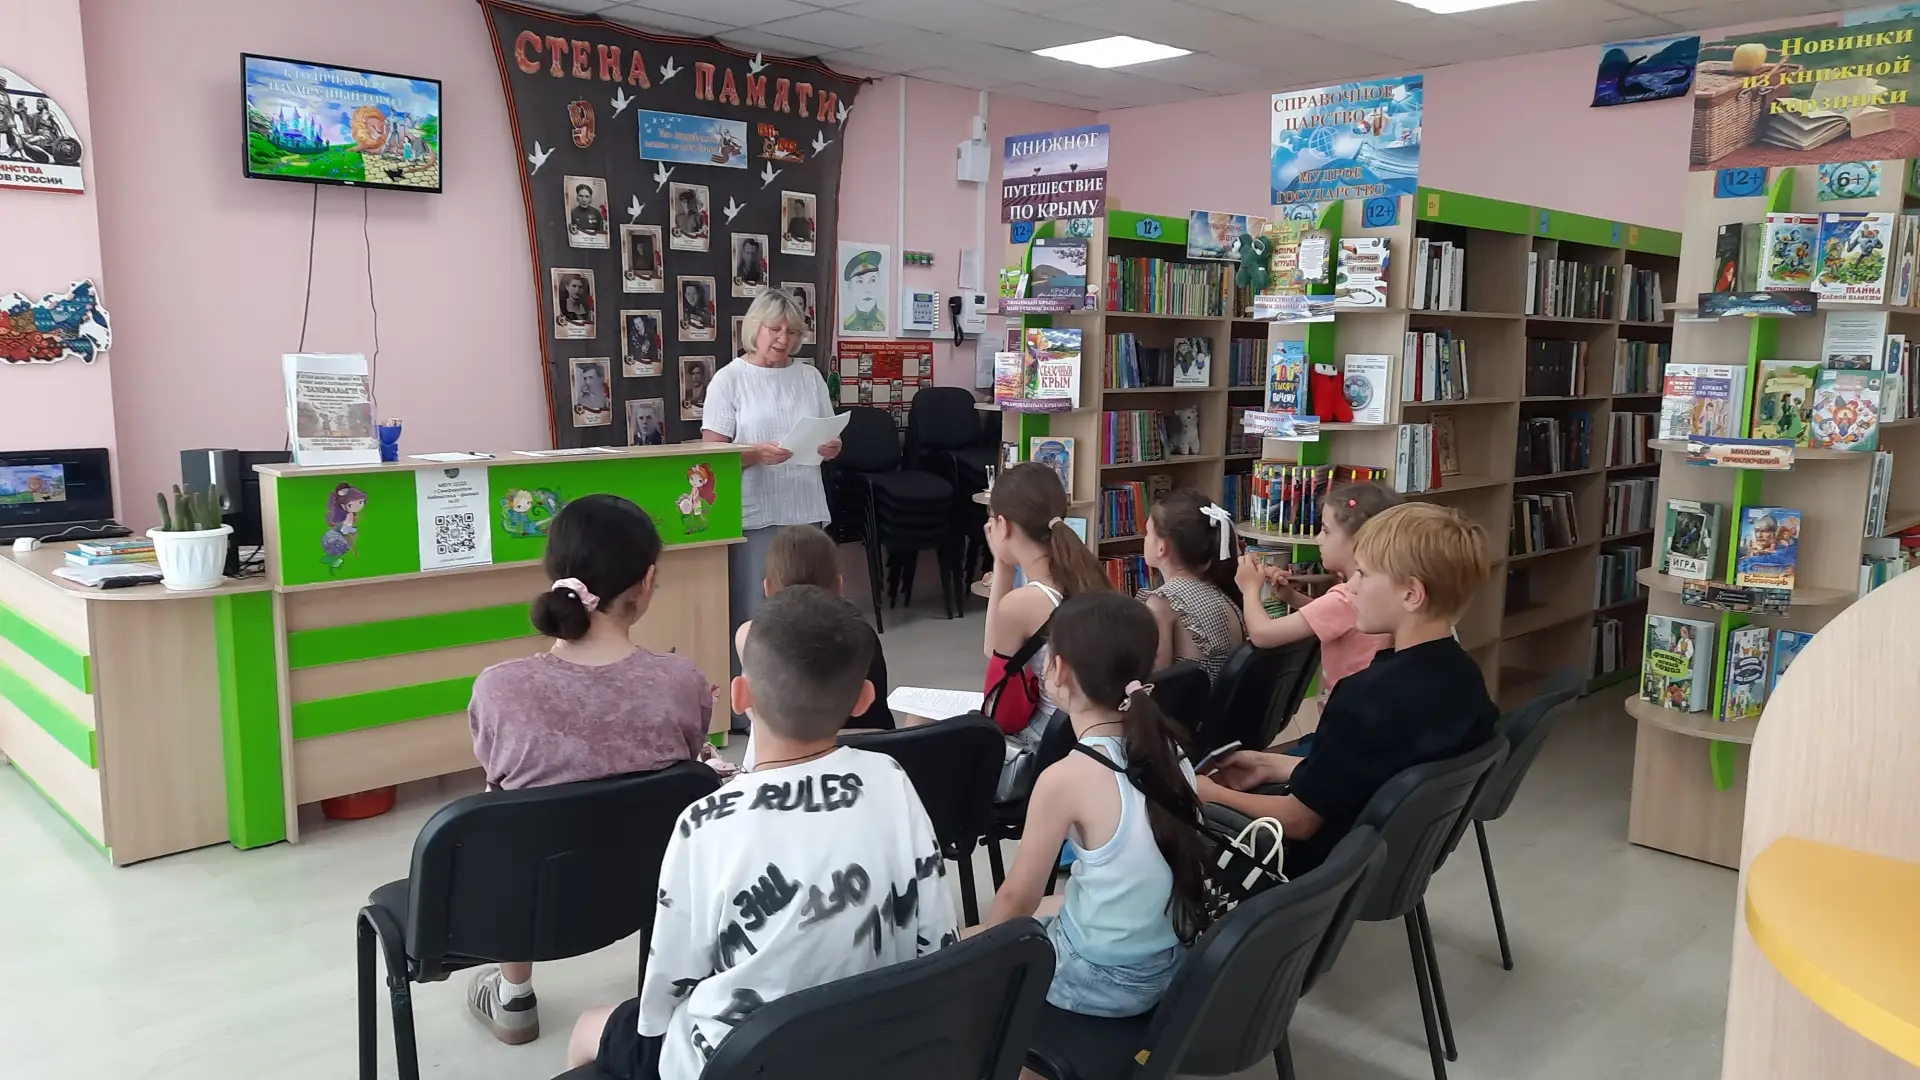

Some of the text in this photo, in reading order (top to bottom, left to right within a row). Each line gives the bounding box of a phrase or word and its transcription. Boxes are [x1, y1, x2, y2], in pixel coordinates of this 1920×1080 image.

[1779, 28, 1914, 58] Новинки
[514, 30, 838, 123] СТЕНА ПАМЯТИ
[1741, 55, 1912, 90] из книжной
[1273, 85, 1395, 113] СПРАВОЧНОЕ
[1769, 89, 1908, 118] корзинки
[1286, 109, 1366, 132] ЦАРСТВО
[1012, 132, 1099, 157] КНИЖНОЕ
[15, 174, 63, 185] РОССИИ
[1299, 166, 1363, 183] МУДРОЕ
[1725, 171, 1762, 187] 12+
[1836, 171, 1865, 188] 6+
[1003, 177, 1103, 199] ПУТЕШЕСТВИЕ
[1276, 184, 1386, 204] ГОСУДАРСТВО
[1009, 199, 1100, 220] ПО КРЫМУ
[1368, 205, 1395, 218] 12+
[1014, 225, 1032, 237] 12+
[1073, 220, 1086, 230] 6+
[1143, 221, 1159, 235] 12+
[1275, 364, 1296, 381] 100
[1041, 376, 1071, 389] КРЫМ
[1722, 456, 1780, 465] ПРИКЛЮЧЕНИЙ
[1731, 448, 1771, 456] МИЛЛИОН
[1672, 558, 1697, 570] ИГРА
[749, 772, 865, 813] RULES
